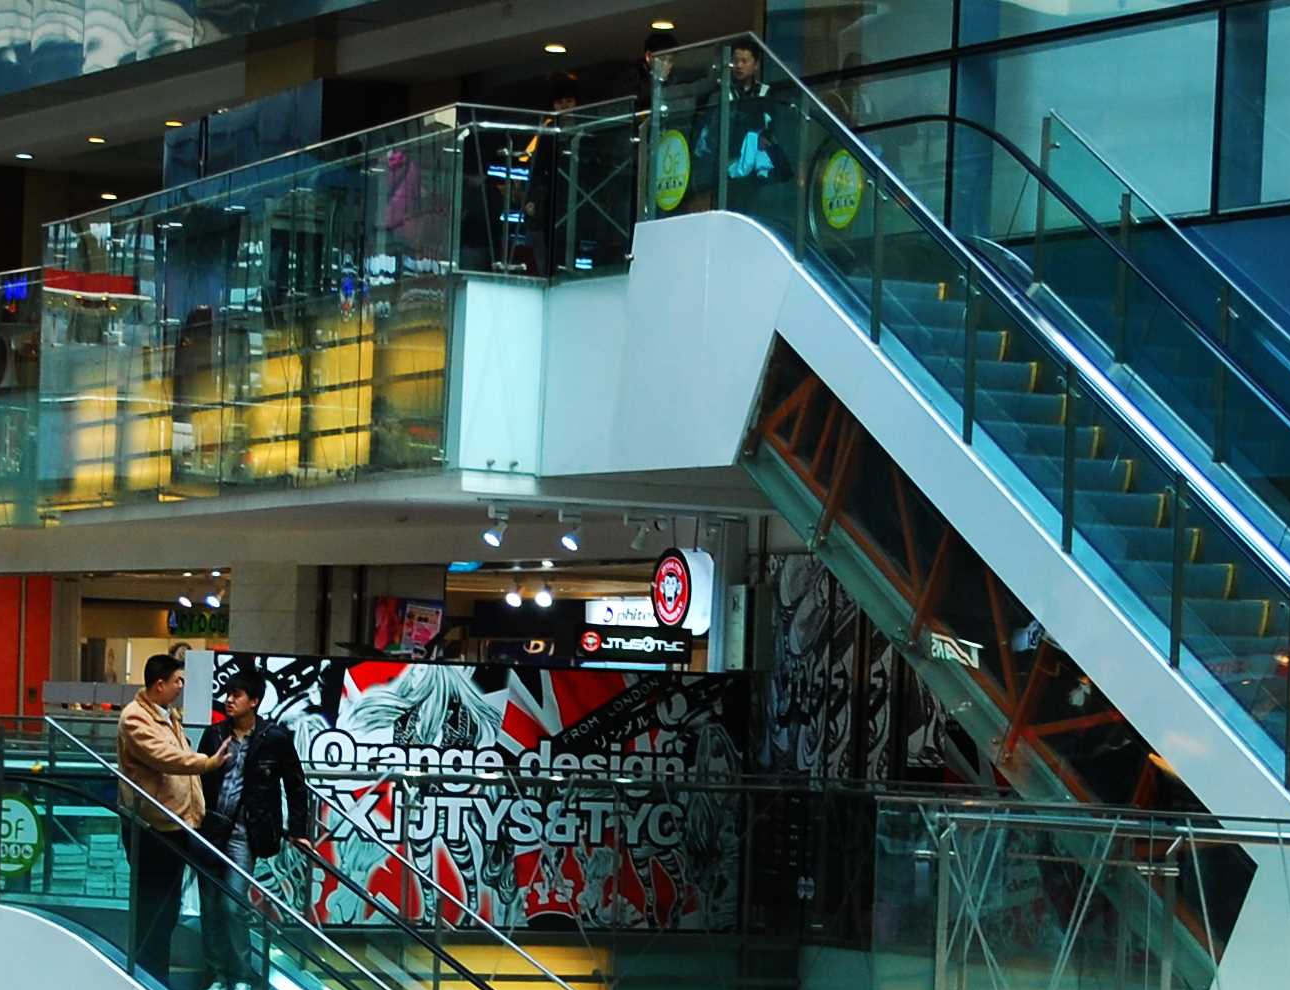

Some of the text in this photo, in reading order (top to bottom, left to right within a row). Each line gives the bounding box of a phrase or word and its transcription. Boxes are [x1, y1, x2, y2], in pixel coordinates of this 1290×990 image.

[561, 677, 660, 744] FROM LONDON
[312, 730, 685, 797] Orange design
